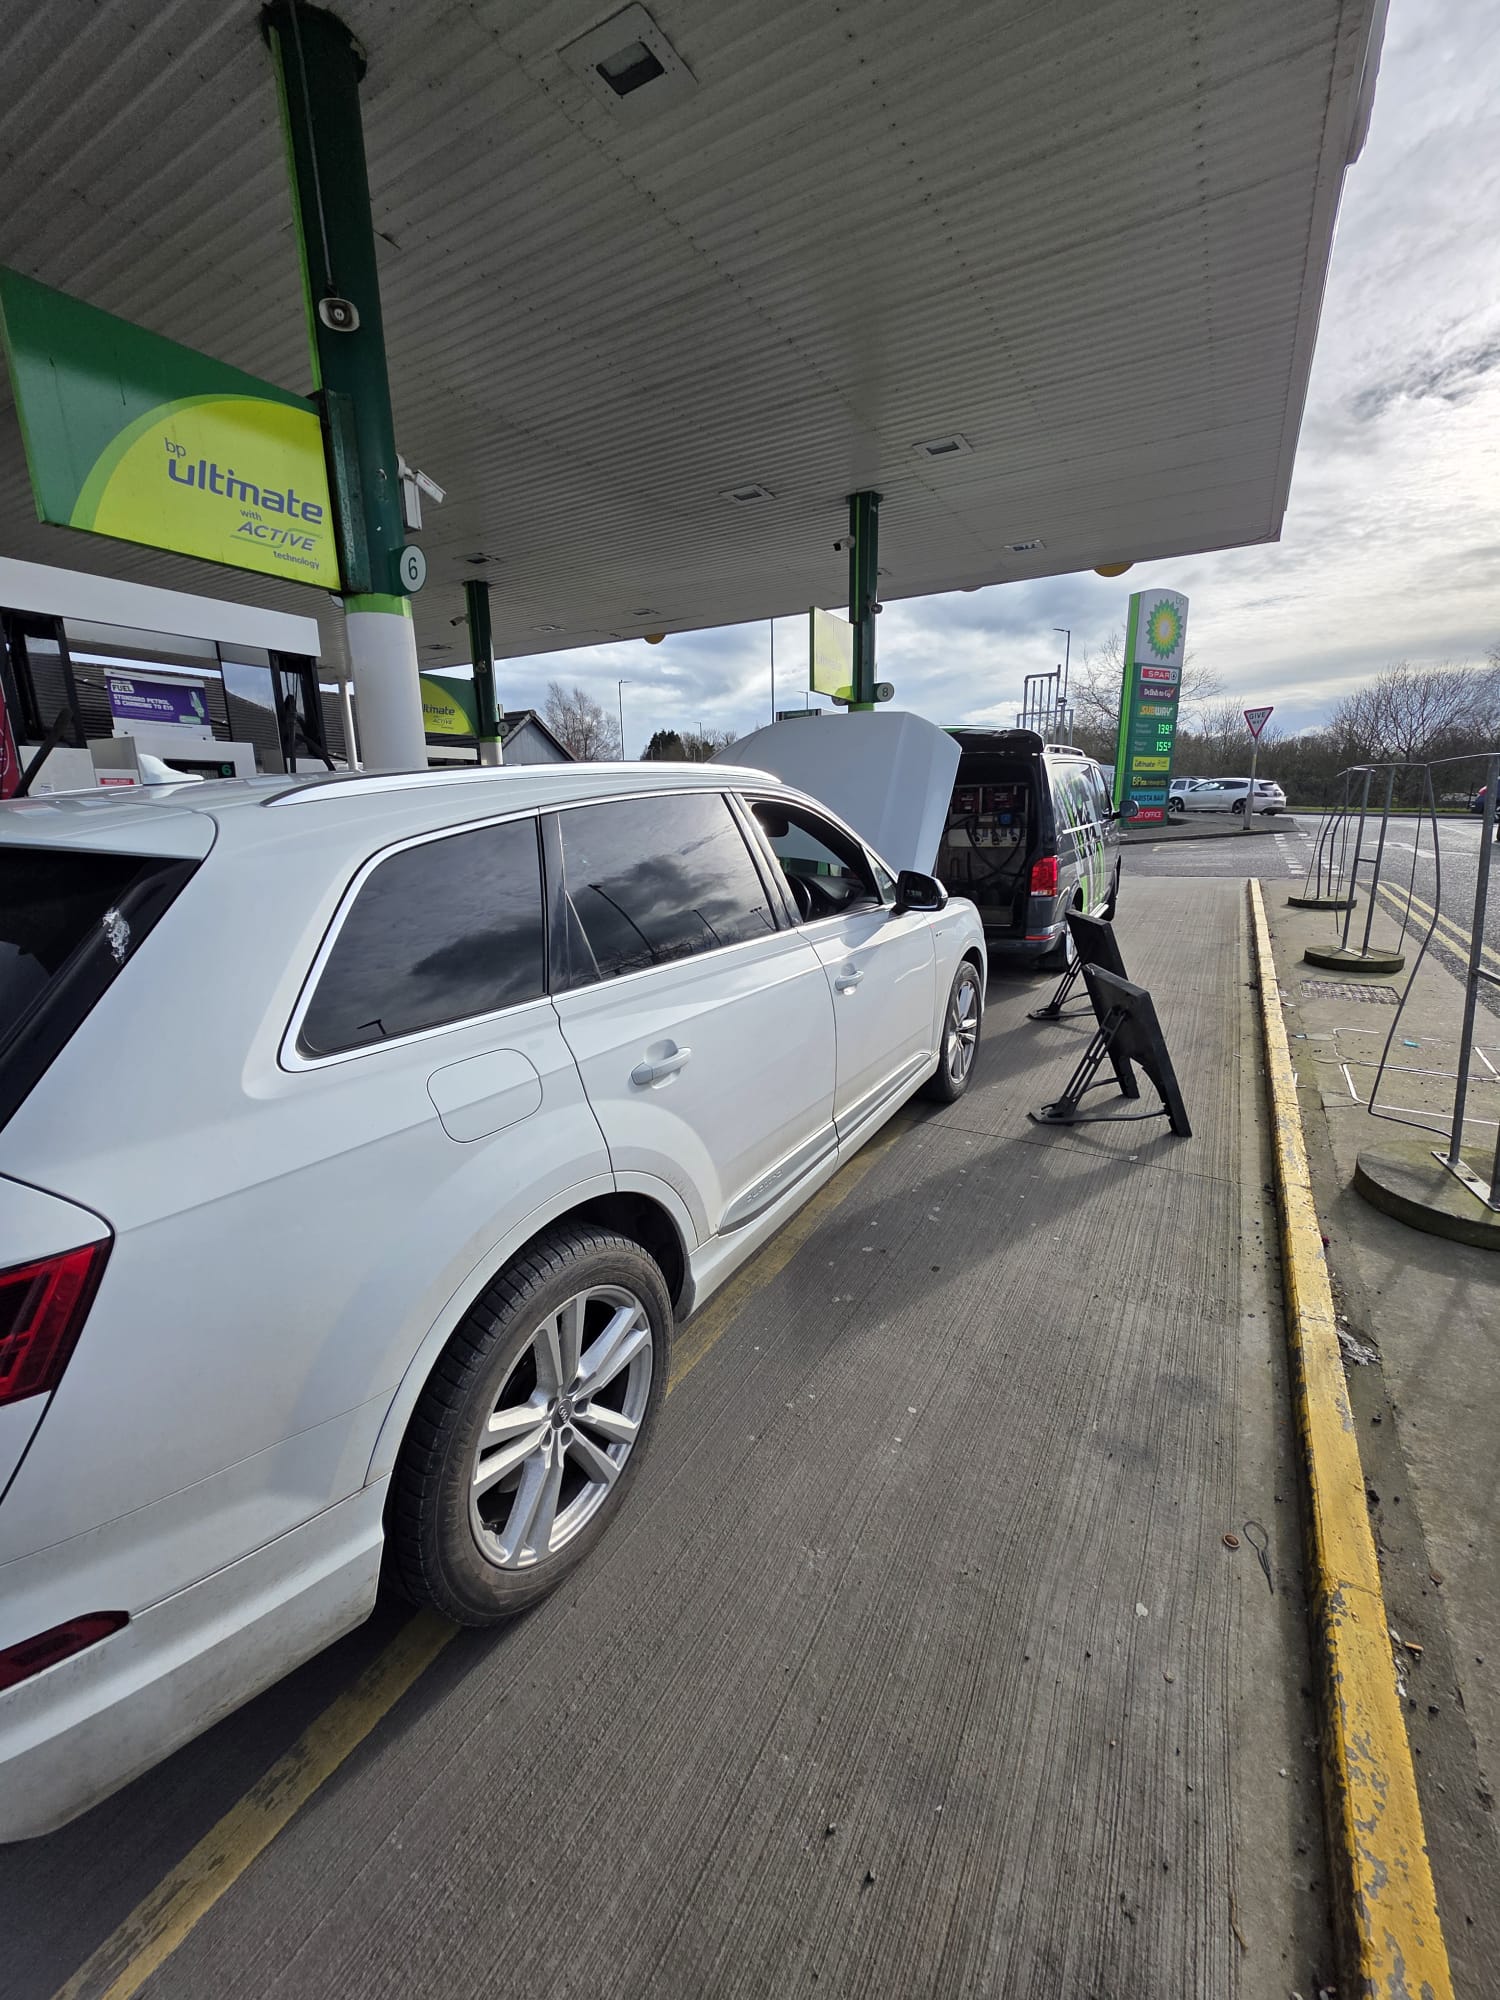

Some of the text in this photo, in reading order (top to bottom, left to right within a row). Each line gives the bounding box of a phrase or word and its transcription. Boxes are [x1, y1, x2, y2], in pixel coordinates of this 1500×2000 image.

[164, 437, 187, 459] bp
[168, 458, 323, 525] ultimate
[240, 509, 262, 522] with
[237, 521, 316, 551] ACTIVE
[273, 551, 320, 571] technology
[408, 556, 418, 580] 6
[1147, 670, 1170, 679] SPAR
[112, 684, 131, 692] FUEL
[882, 685, 889, 698] 8
[423, 704, 456, 716] ltimate
[1139, 705, 1173, 716] SUBWAY
[1249, 711, 1266, 720] GIVE
[221, 764, 232, 776] 6
